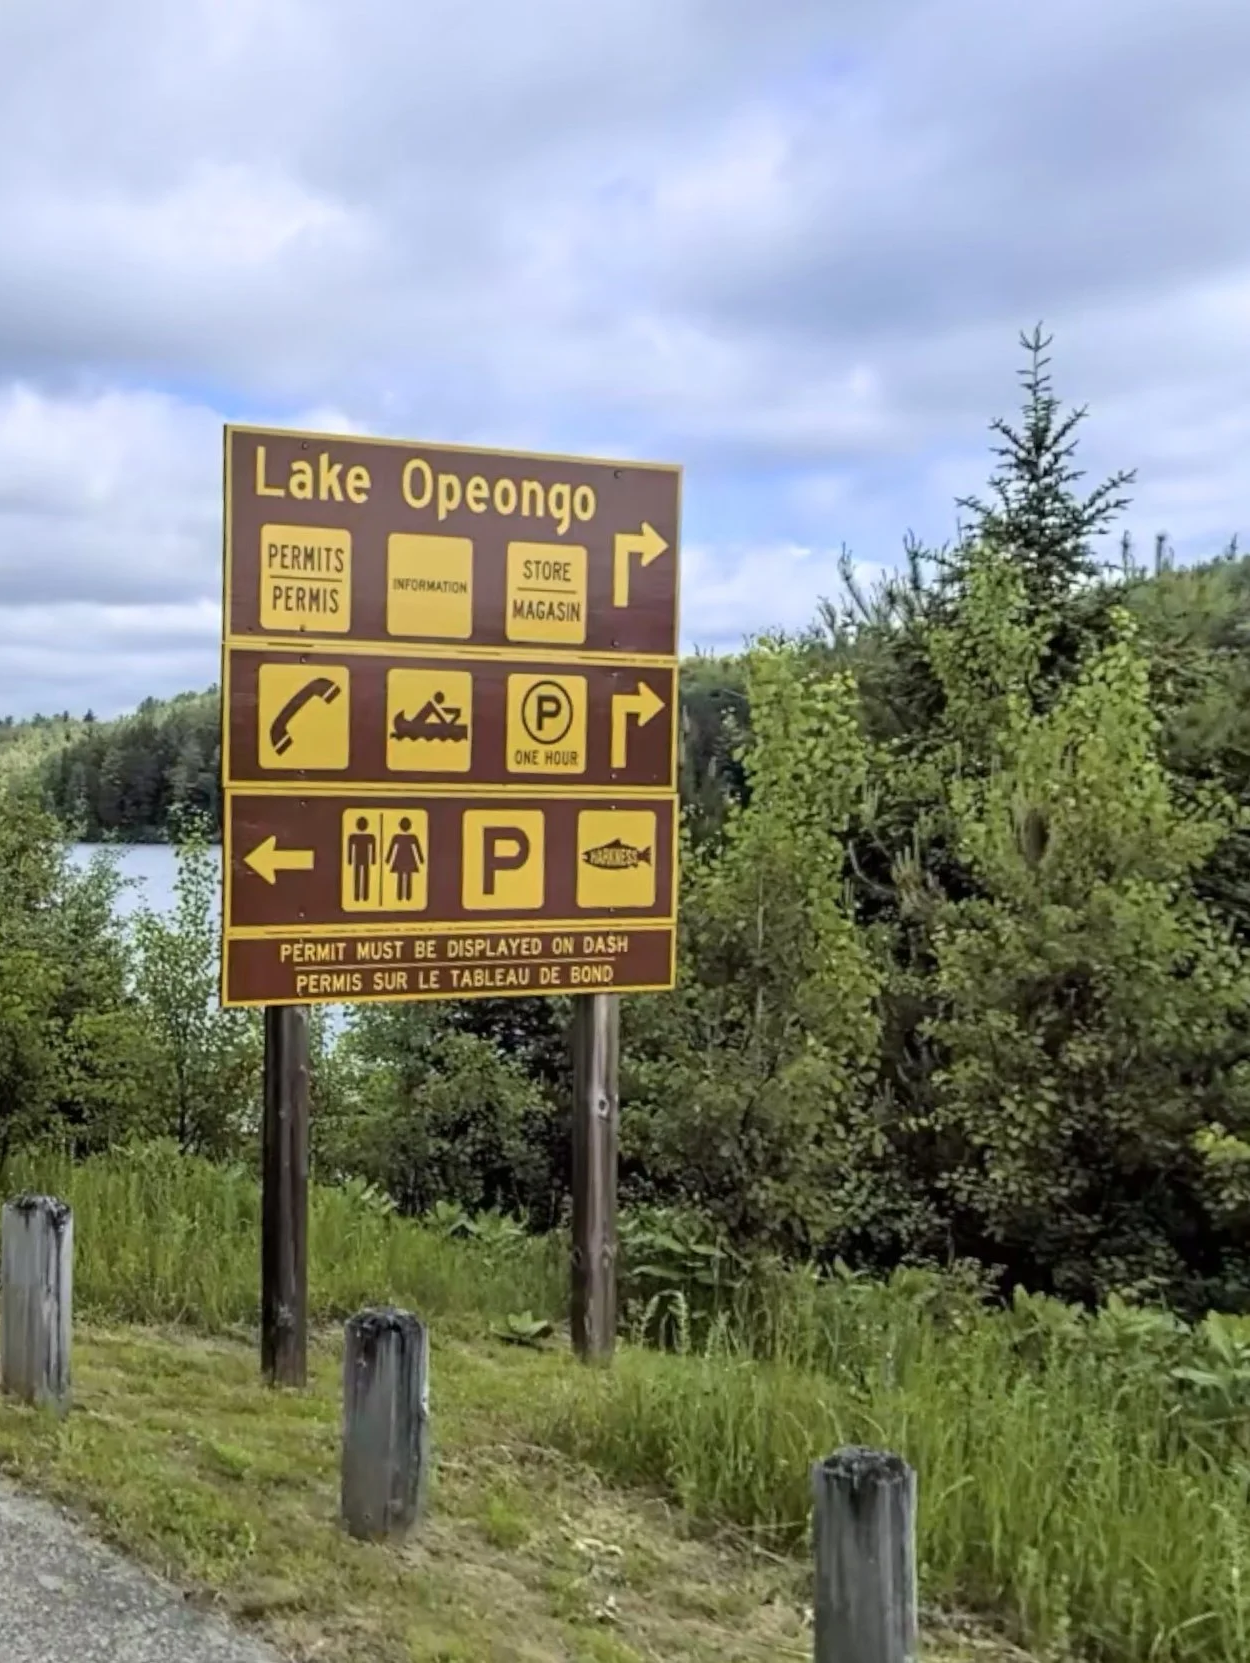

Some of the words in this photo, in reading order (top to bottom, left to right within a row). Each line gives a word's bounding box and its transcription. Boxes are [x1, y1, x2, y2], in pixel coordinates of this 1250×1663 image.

[255, 445, 372, 503] Lake
[402, 458, 597, 535] Opeongo
[268, 543, 345, 574] PERMITS
[523, 559, 572, 582] STORE
[272, 584, 339, 615] PERMIS
[393, 578, 467, 594] INFORMATION
[512, 600, 581, 623] MAGASIN
[536, 694, 561, 731] P
[515, 750, 539, 765] ONE
[544, 751, 578, 766] HOUR
[482, 826, 531, 895] P
[279, 942, 347, 963] PERMIT
[356, 941, 404, 960] MUST
[414, 940, 437, 959] BE
[446, 937, 543, 958] DISPLAYED
[552, 936, 575, 955] ON
[583, 935, 629, 953] DASH
[296, 973, 363, 994] PERMIS
[373, 971, 408, 991] SUR
[418, 970, 441, 989] LE
[450, 967, 531, 988] TABLEAU
[539, 966, 561, 984] DE
[570, 964, 614, 983] BOND
